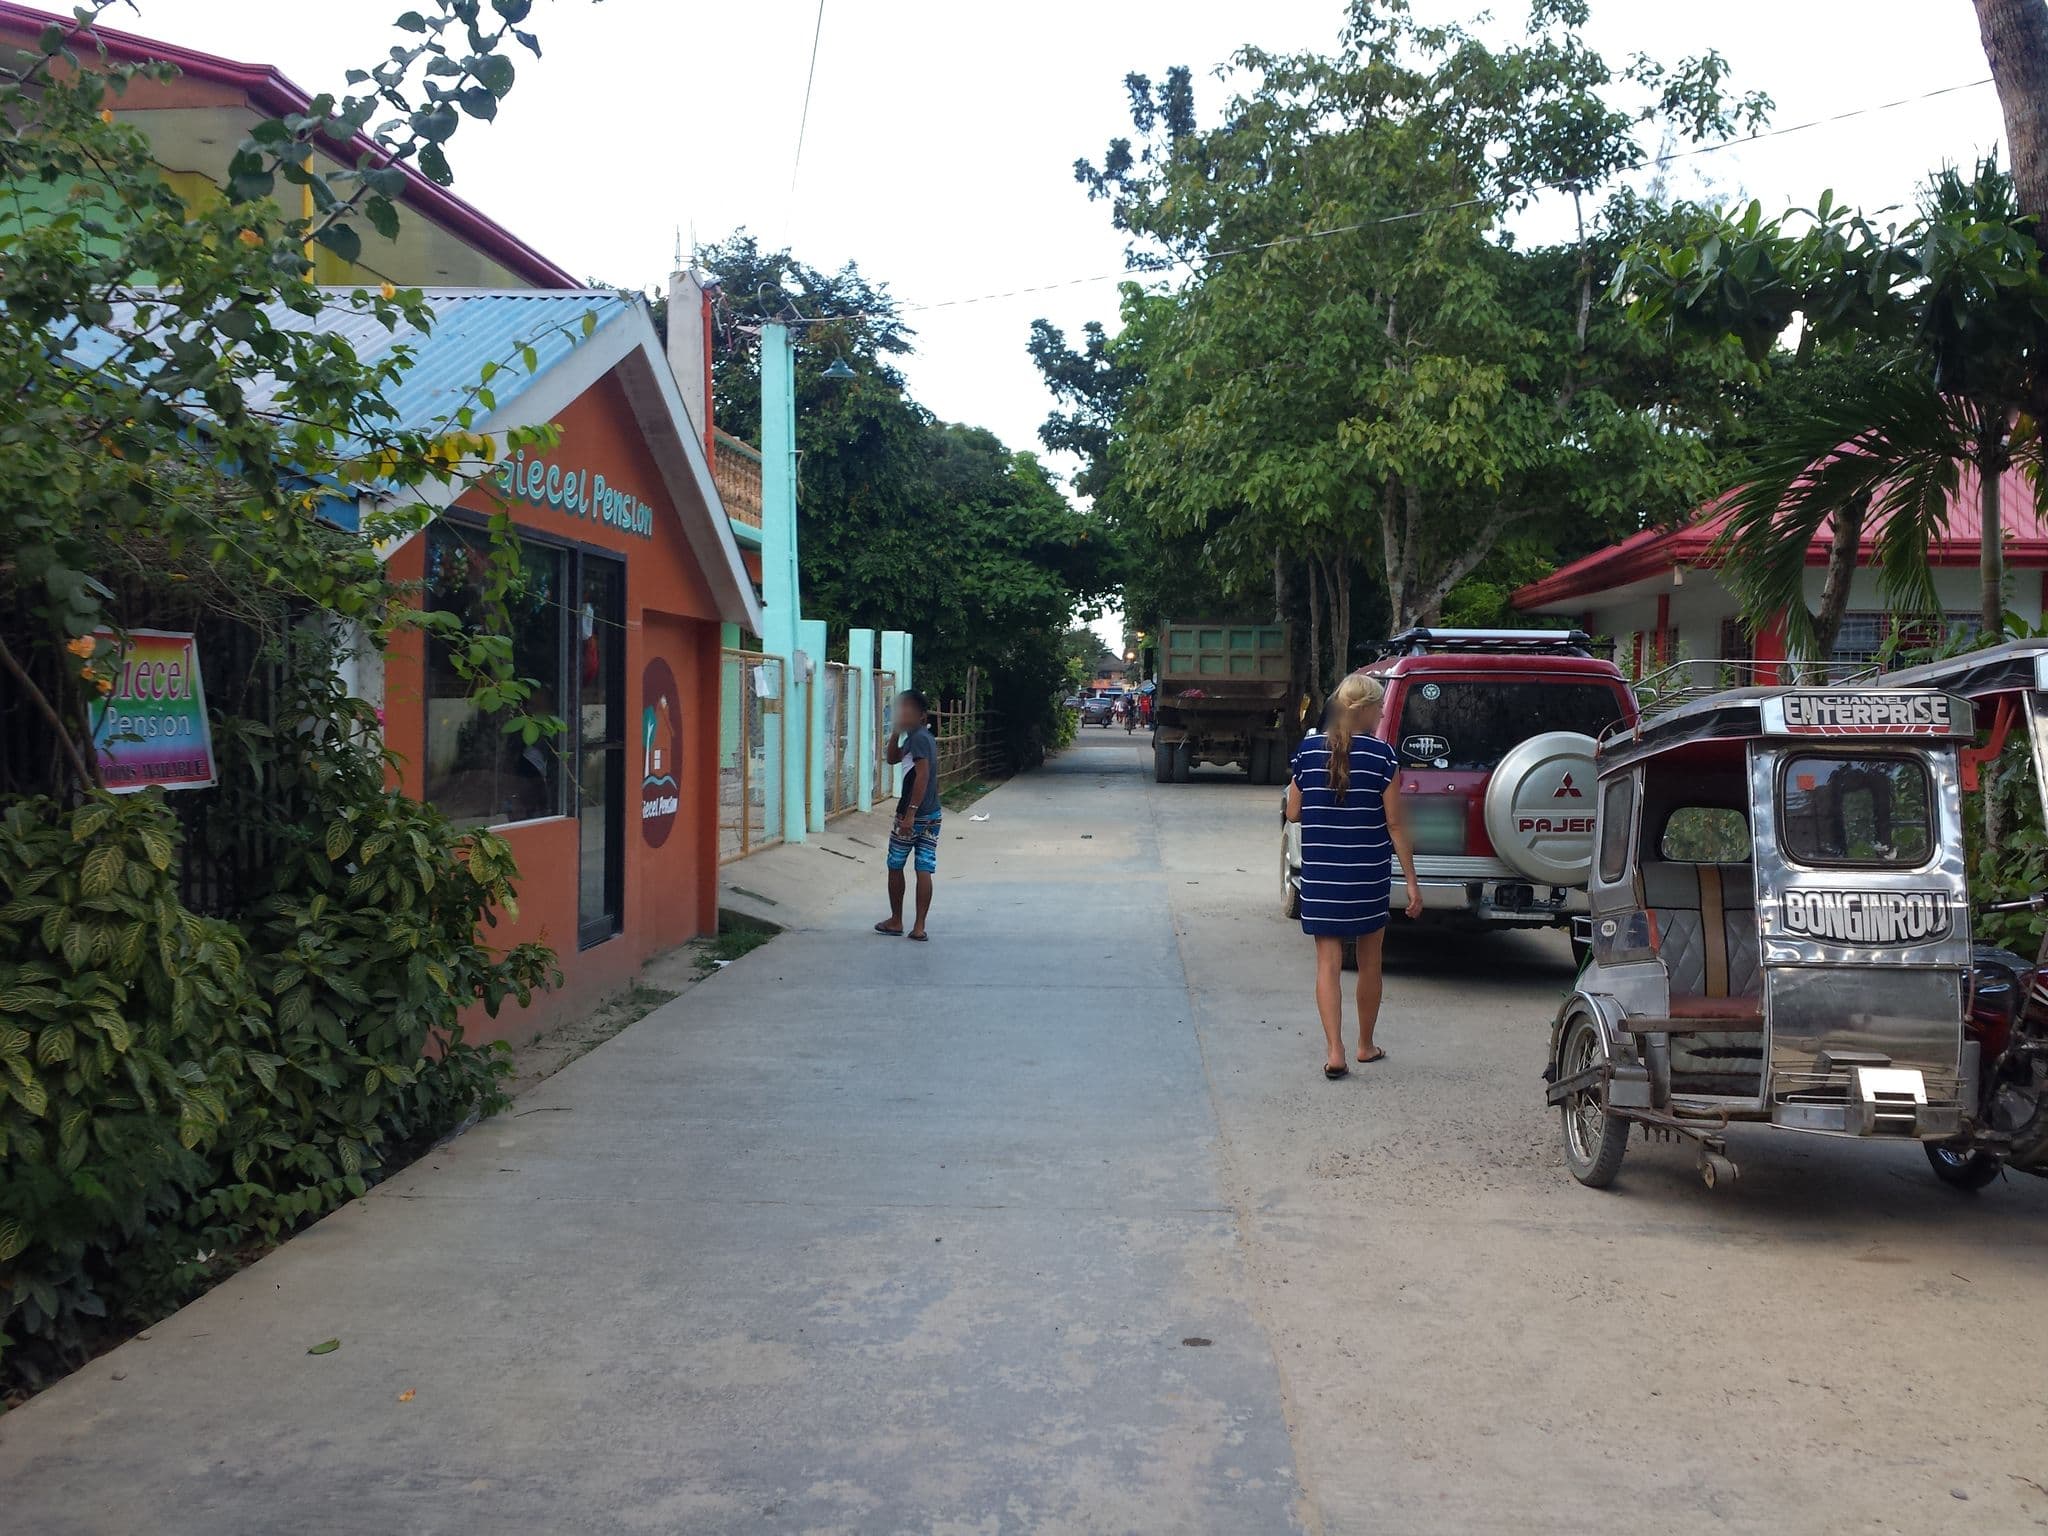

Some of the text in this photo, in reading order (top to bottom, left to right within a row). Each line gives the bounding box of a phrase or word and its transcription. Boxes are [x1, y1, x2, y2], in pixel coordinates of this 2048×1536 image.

[593, 474, 653, 536] Pension
[103, 643, 193, 700] iecel
[1783, 695, 1951, 725] ENTERPRISE
[1822, 696, 1908, 705] CHANNEL
[107, 706, 191, 737] Pension
[642, 797, 659, 818] iecel
[1518, 817, 1596, 833] PAJER
